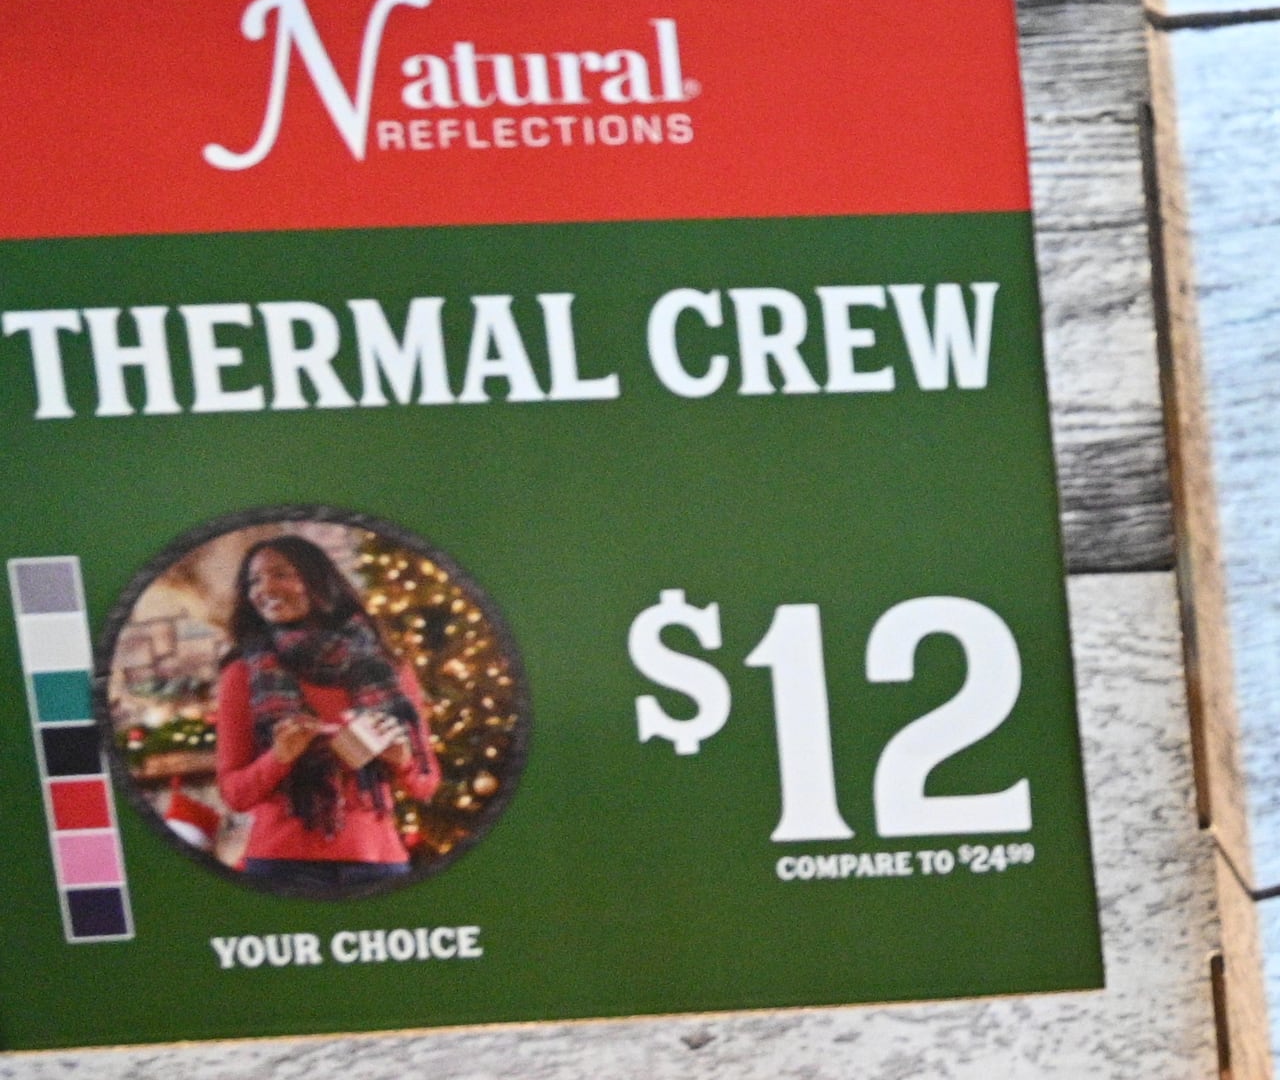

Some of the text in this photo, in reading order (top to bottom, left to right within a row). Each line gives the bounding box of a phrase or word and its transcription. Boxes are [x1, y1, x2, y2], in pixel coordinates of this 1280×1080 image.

[377, 113, 694, 151] REFLECTIONS
[1, 281, 999, 420] THERMAL CREW
[628, 588, 1032, 842] $12
[775, 851, 914, 881] COMPARE
[916, 849, 955, 874] TO
[210, 925, 484, 969] YOUR CHOICE
